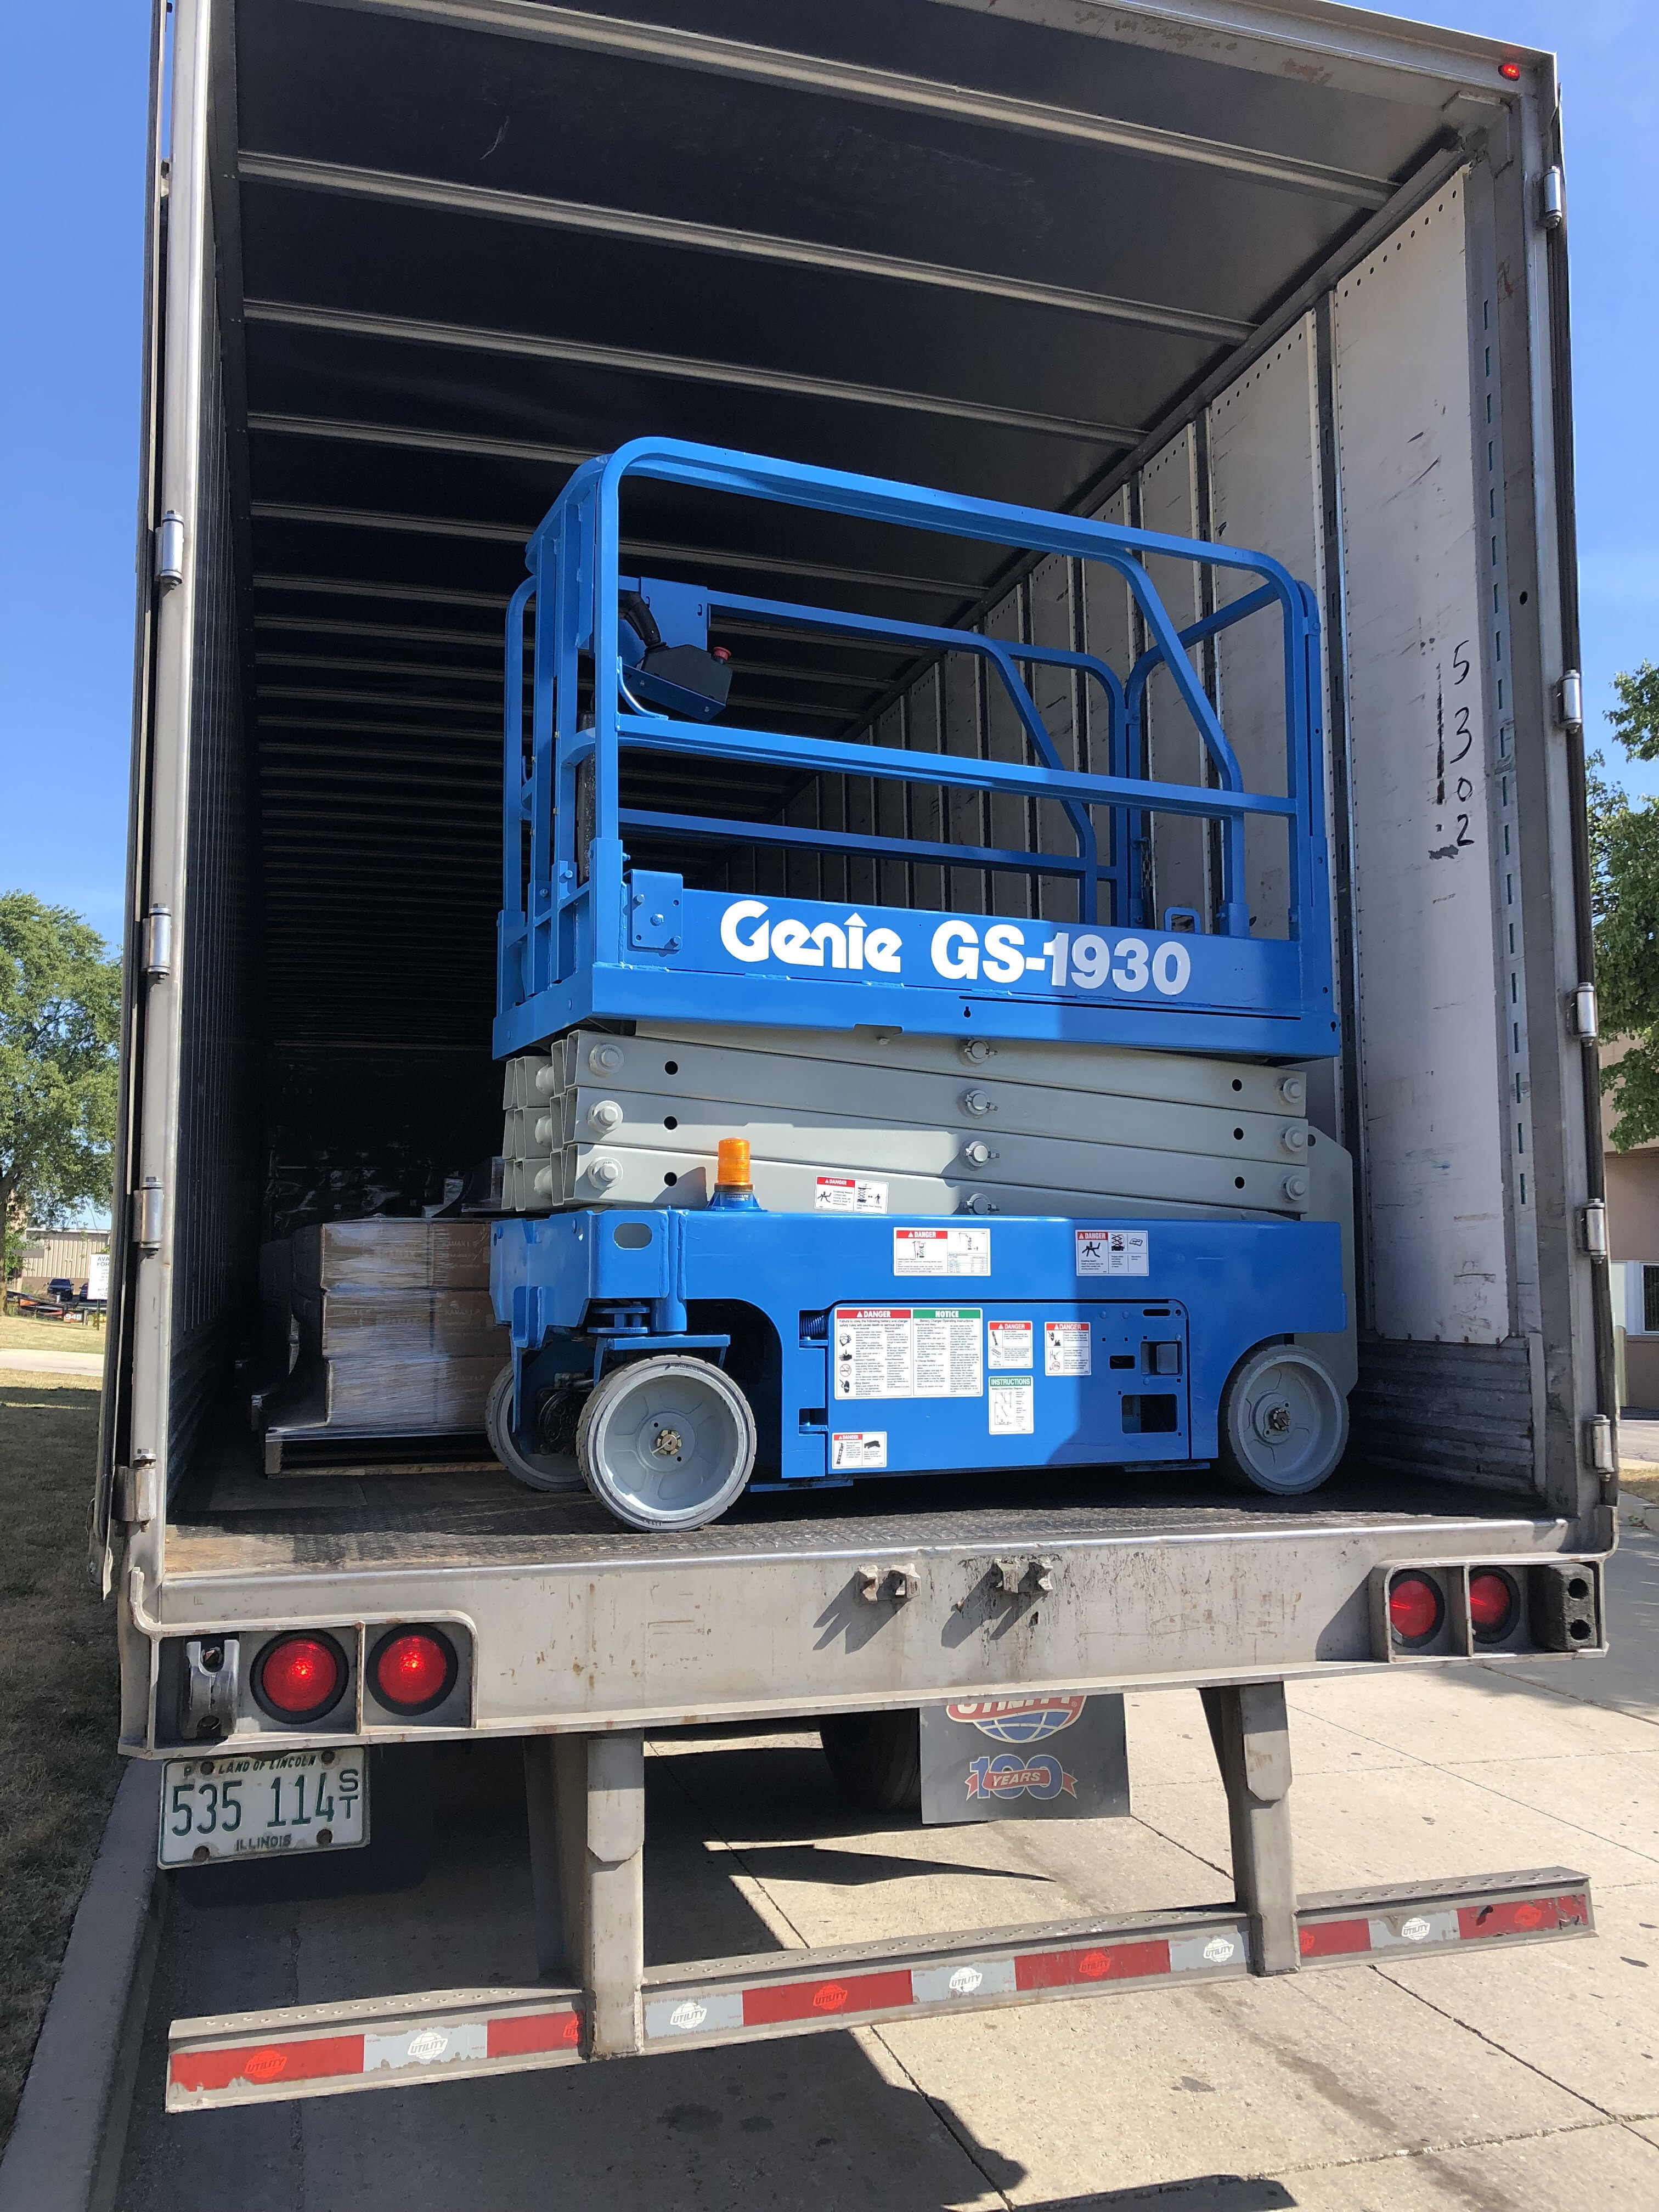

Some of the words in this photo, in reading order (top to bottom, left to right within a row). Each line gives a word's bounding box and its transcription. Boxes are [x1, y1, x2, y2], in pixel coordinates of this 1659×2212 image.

[720, 899, 902, 974] Genie
[930, 919, 1192, 996] GS-1930
[218, 1761, 250, 1774] LAND
[253, 1760, 266, 1771] OF
[269, 1756, 317, 1770] LINCOLN
[992, 1772, 1041, 1787] YEARS
[171, 1780, 242, 1837] 535
[267, 1772, 335, 1828] 114
[236, 1833, 292, 1852] ILLINOIS
[1403, 1925, 1429, 1936] UTILITY
[1205, 1945, 1233, 1957] UTILITY
[951, 1974, 981, 1987] UTILITY
[815, 1991, 846, 2005] UTILITY
[673, 2010, 705, 2023] UTILITY
[411, 2040, 446, 2054] UTILITY
[247, 2057, 285, 2072] UTILITY
